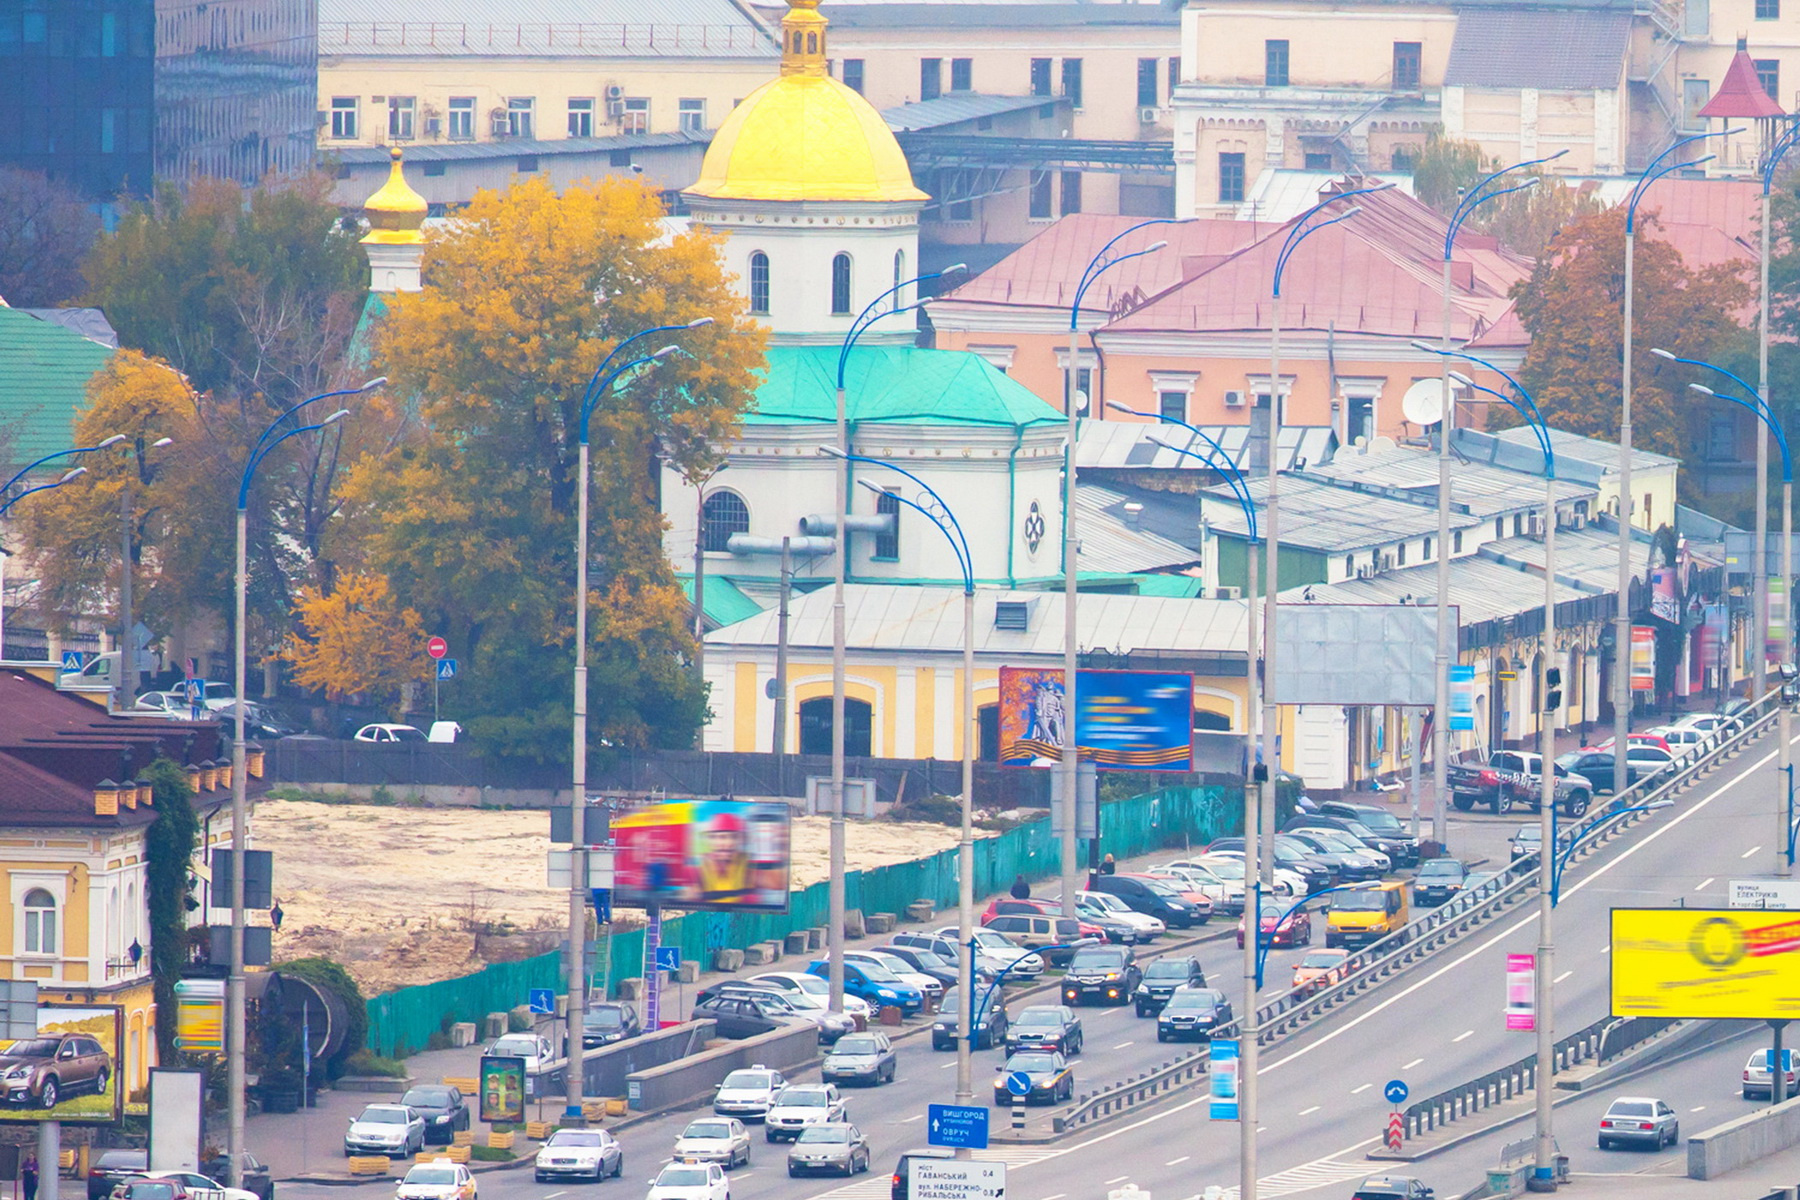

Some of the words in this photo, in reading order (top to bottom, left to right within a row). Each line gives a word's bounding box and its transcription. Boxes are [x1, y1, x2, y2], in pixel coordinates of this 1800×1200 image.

[1737, 891, 1778, 899] ЕЛЕКТРИКІВ
[943, 1110, 985, 1120] ВИШГОРОД
[943, 1128, 970, 1136] ОВРУЧ
[918, 1172, 967, 1180] ГАВАНСЬКИЙ
[933, 1183, 982, 1192] НАБЕРЕЖНО-
[918, 1191, 967, 1199] РИБАЛЬСЬКА
